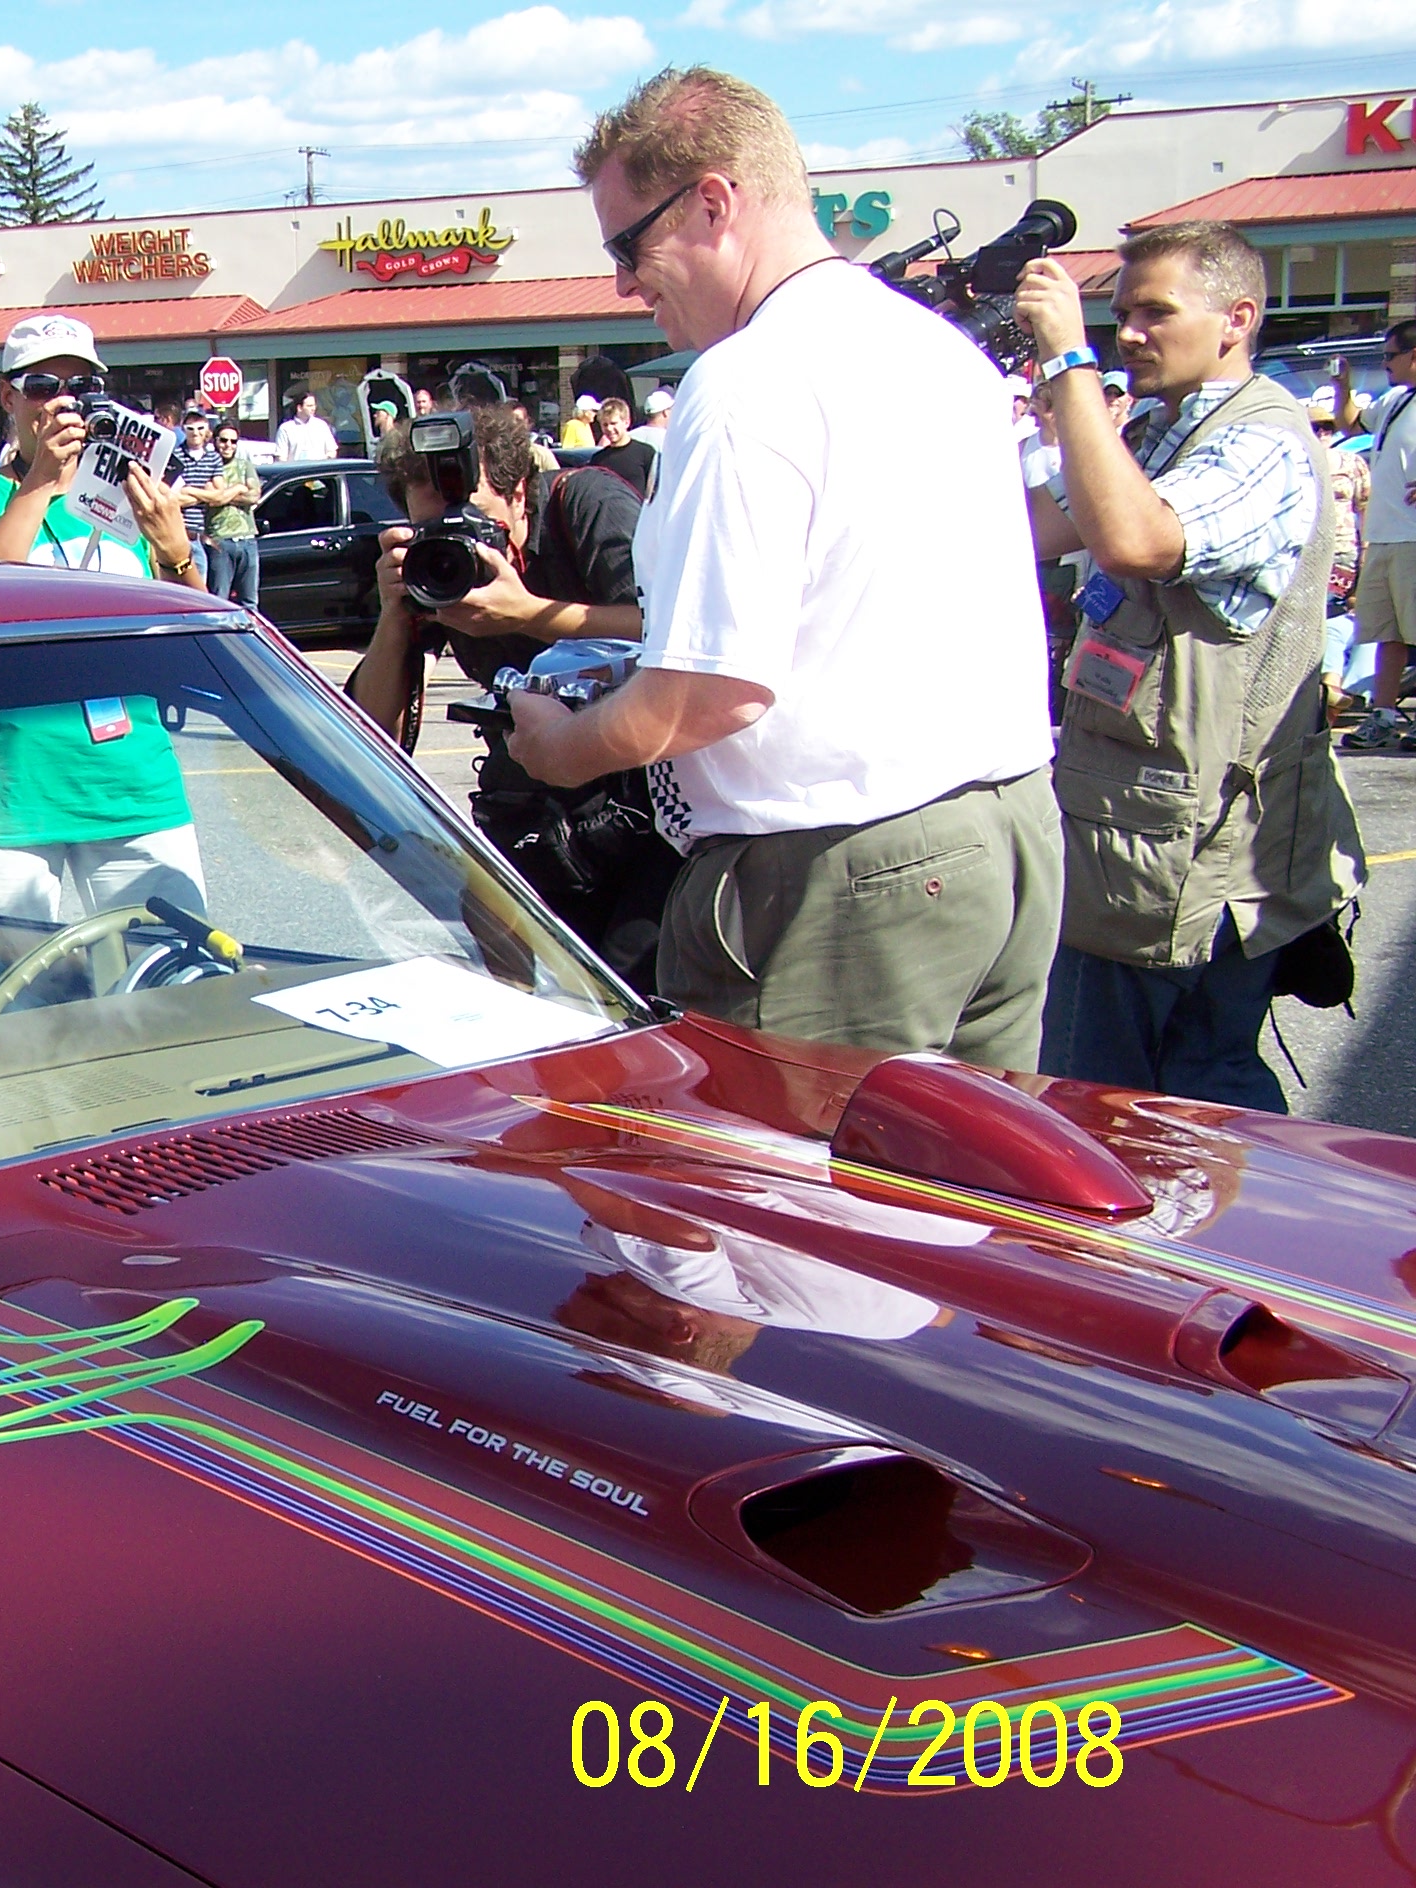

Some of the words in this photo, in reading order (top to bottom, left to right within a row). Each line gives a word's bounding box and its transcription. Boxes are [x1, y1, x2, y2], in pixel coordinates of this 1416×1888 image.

[1346, 98, 1416, 156] K
[90, 228, 191, 257] WEIGHT
[319, 207, 513, 273] Hallmark
[72, 252, 211, 284] WATCHERS
[385, 257, 416, 271] GOLD
[421, 256, 460, 274] CROWN
[204, 372, 239, 392] STOP
[315, 996, 402, 1023] 7-34
[375, 1390, 444, 1429] FUEL
[447, 1418, 508, 1452] FOR
[511, 1442, 570, 1479] THE
[568, 1468, 649, 1517] SOUL
